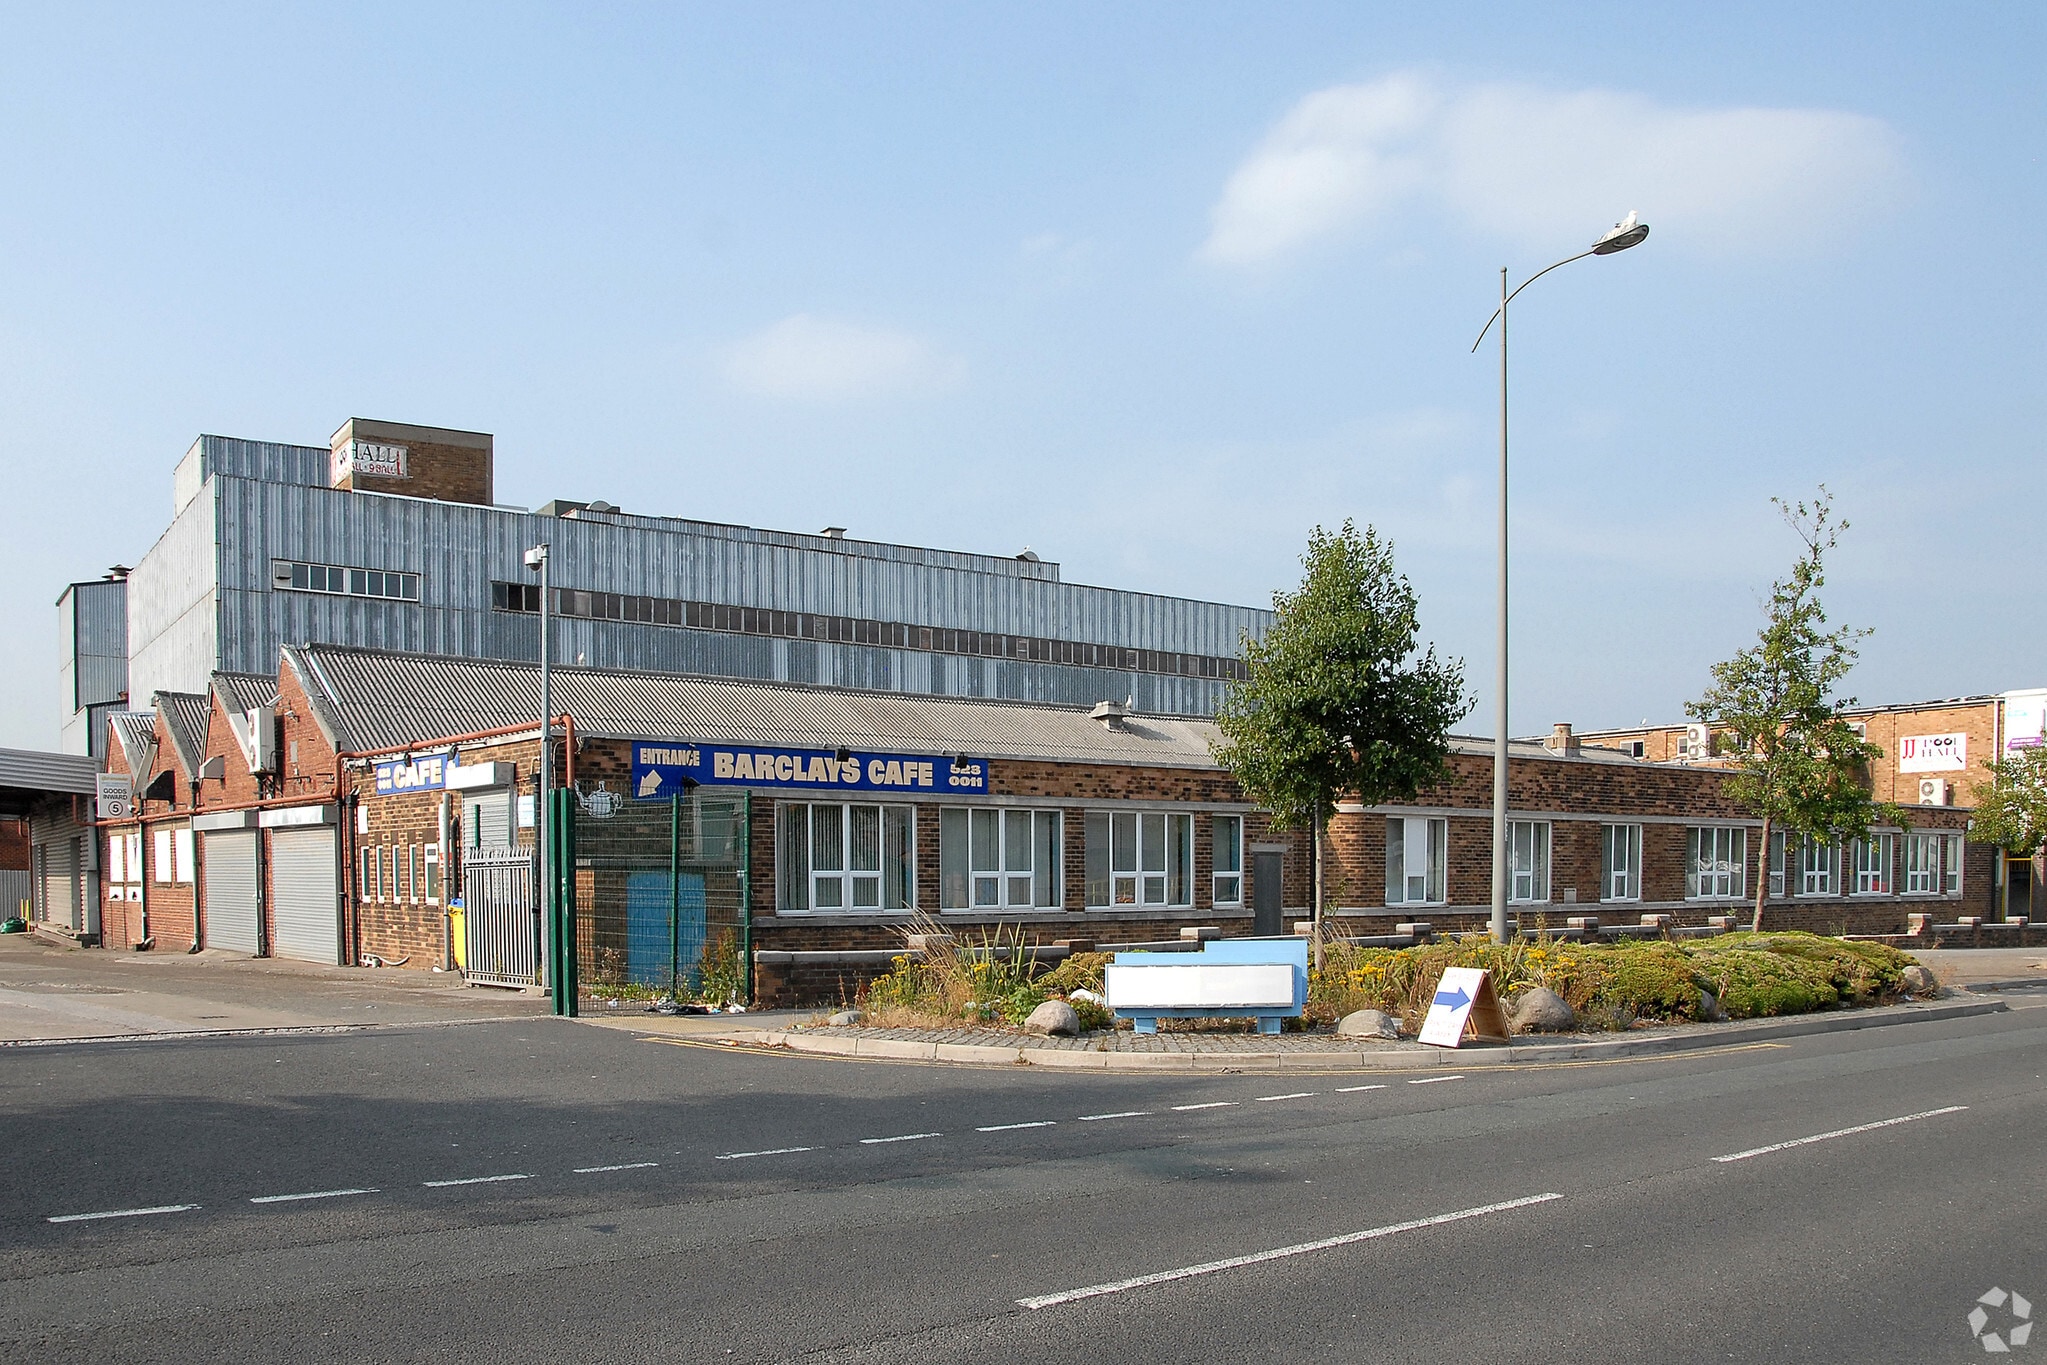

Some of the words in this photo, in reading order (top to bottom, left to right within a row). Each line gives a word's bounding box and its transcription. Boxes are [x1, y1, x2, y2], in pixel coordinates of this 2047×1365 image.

[640, 748, 700, 767] ENTRANCE
[1902, 738, 1916, 759] JJ
[393, 759, 442, 789] CAFE
[713, 752, 861, 784] BARCLAYS
[868, 759, 933, 787] CAFE
[948, 776, 983, 788] 0011
[112, 804, 119, 813] 5
